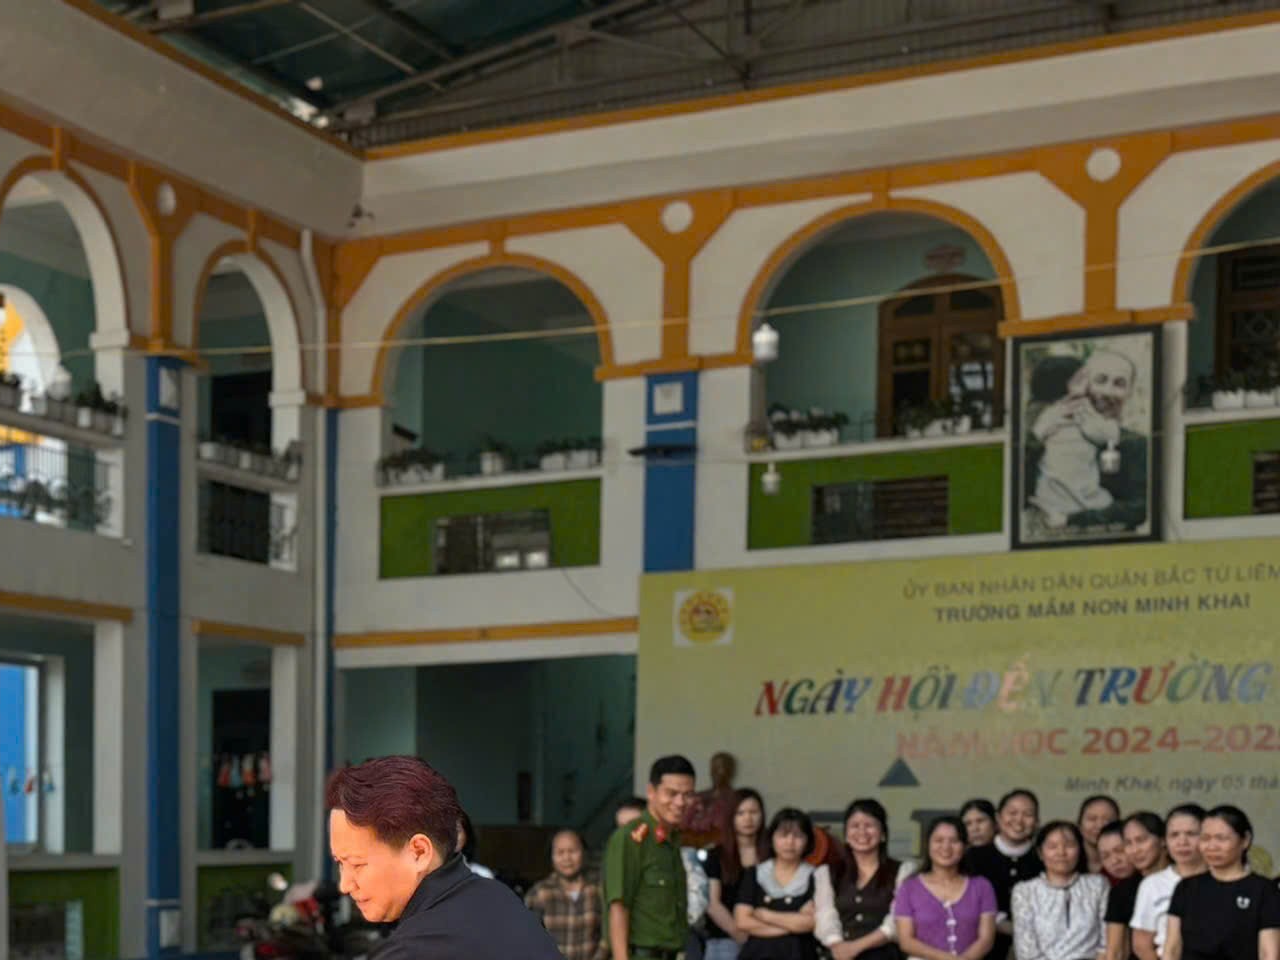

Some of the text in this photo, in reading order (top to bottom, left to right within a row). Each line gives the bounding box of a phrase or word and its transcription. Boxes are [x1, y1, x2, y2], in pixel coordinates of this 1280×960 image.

[934, 580, 975, 598] BAN
[1082, 598, 1128, 617] NON
[1135, 594, 1190, 614] MINH
[1198, 592, 1252, 612] KHAI
[754, 666, 873, 718] NGÀY
